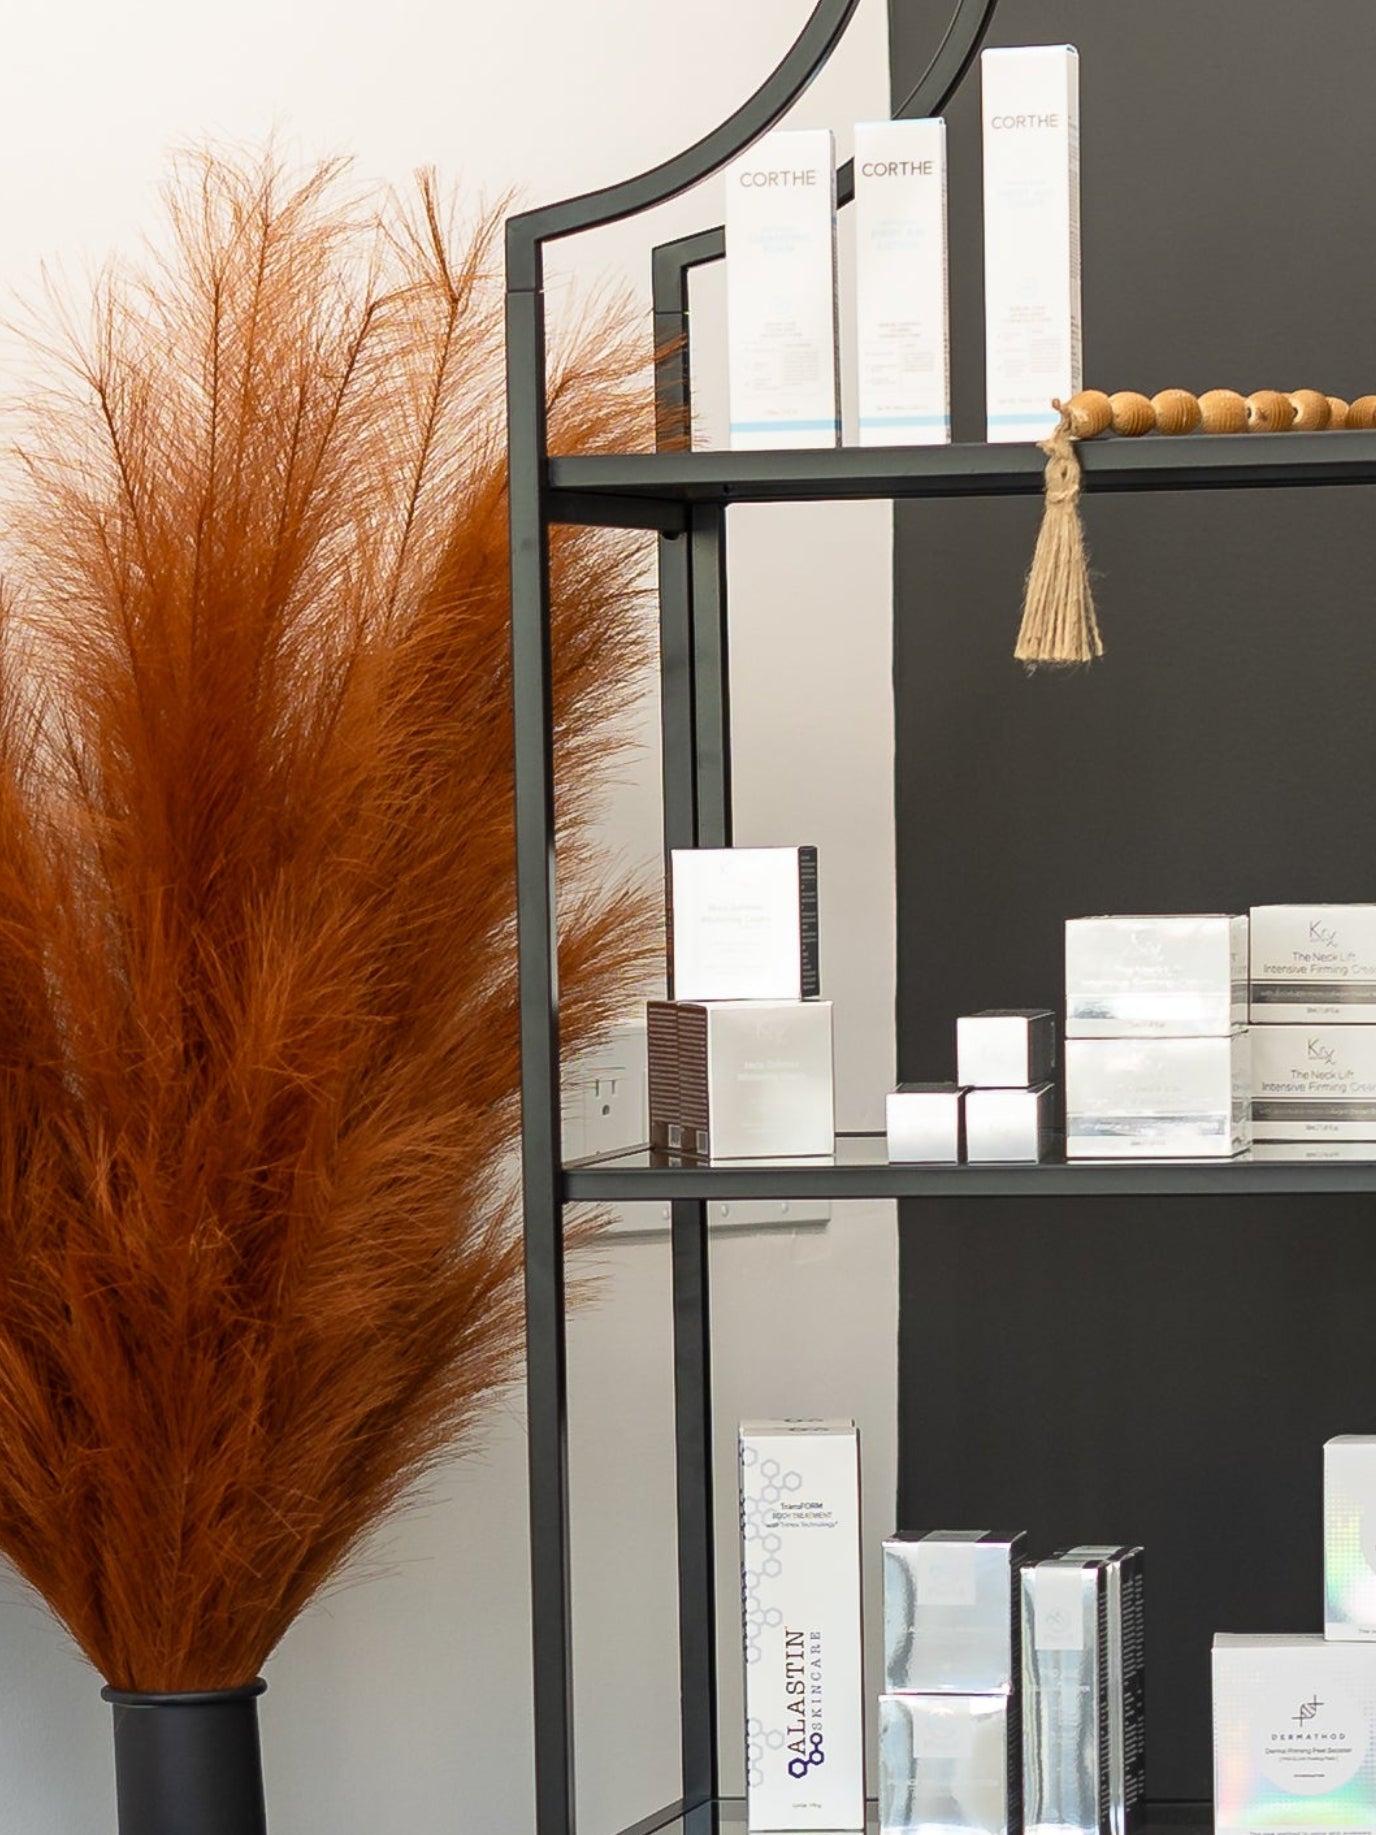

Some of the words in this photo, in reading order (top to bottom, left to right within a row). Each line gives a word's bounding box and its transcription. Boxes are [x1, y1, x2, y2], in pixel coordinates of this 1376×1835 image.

[990, 113, 1059, 130] CORTHE
[861, 160, 933, 177] CORTHE
[739, 169, 817, 189] CORTHE
[1292, 951, 1311, 962] The
[1312, 952, 1338, 962] Neck
[1263, 964, 1308, 974] Intensive
[1310, 964, 1349, 976] Firming
[1291, 1069, 1309, 1080] The
[1311, 1070, 1336, 1080] Neck
[1262, 1082, 1306, 1092] Intensive
[1308, 1082, 1347, 1094] Firming
[810, 1631, 823, 1731] SKINCARE
[785, 1629, 807, 1757] ALASTIN
[1271, 1733, 1346, 1741] DERMATHOD
